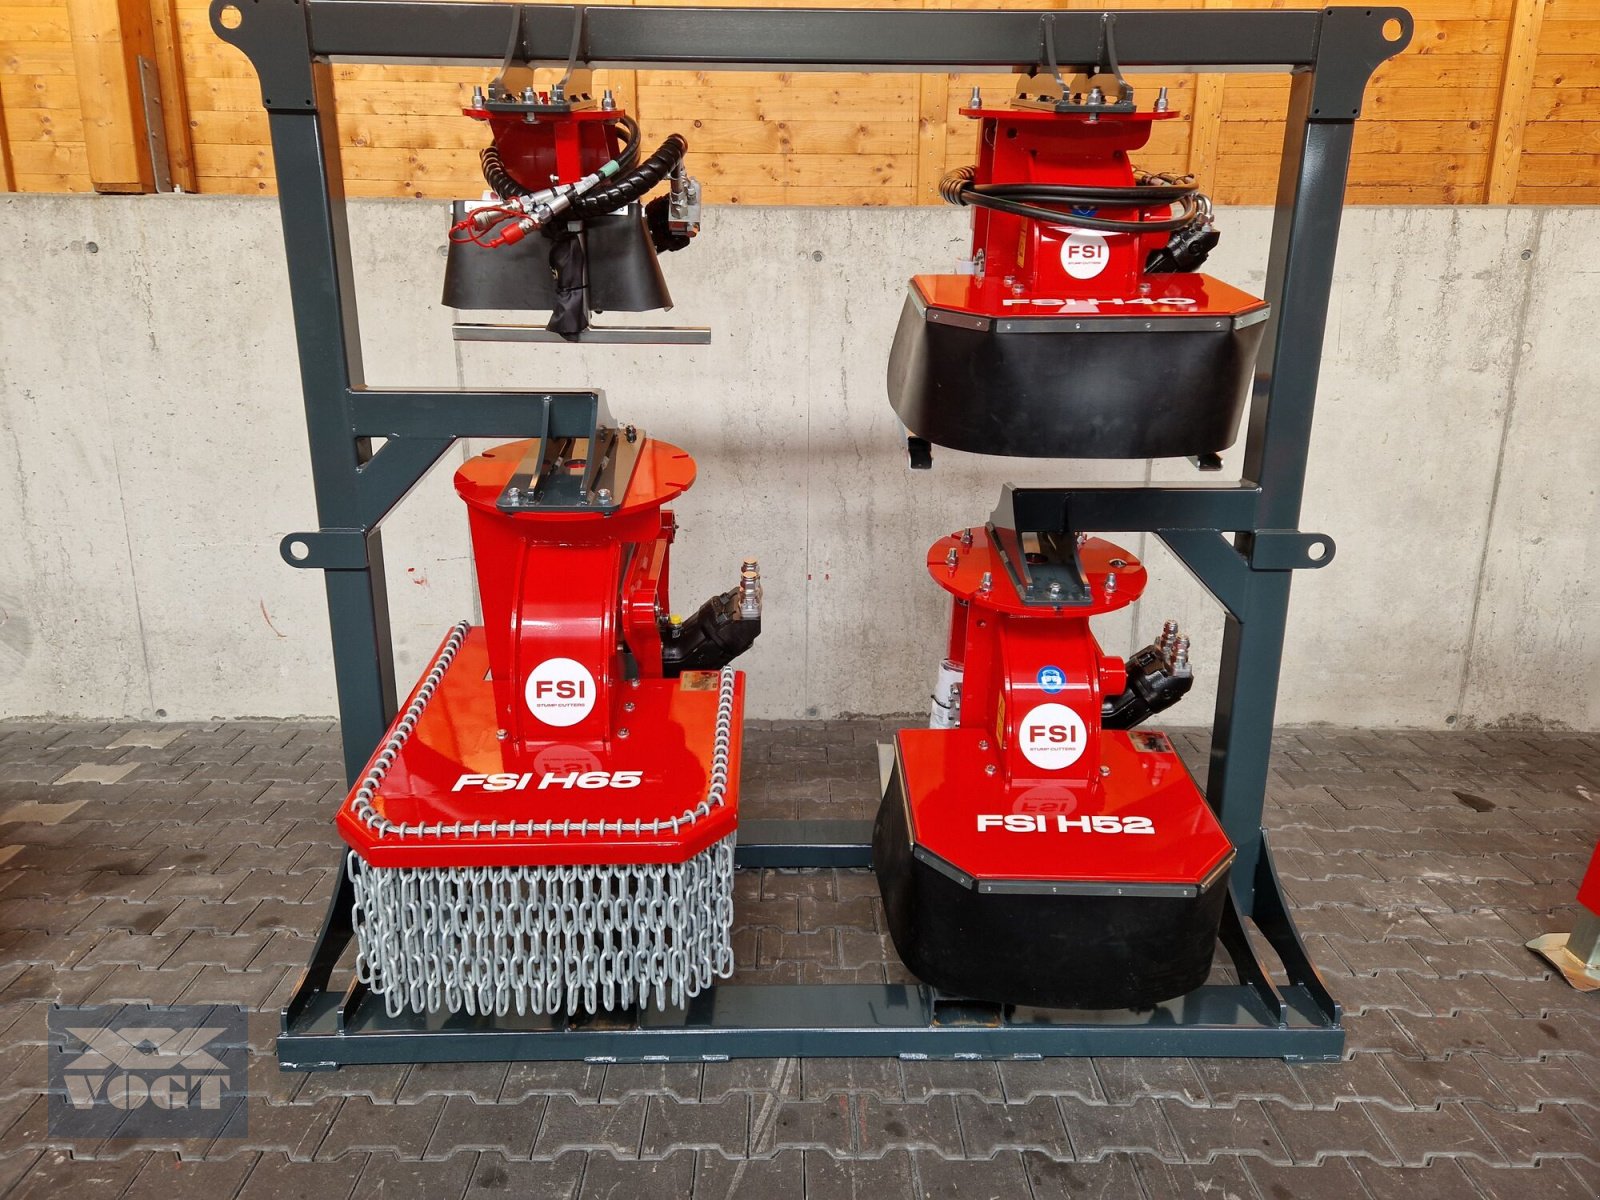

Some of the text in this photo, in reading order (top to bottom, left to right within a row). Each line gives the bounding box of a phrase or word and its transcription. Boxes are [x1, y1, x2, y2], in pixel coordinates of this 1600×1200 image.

[1068, 245, 1102, 258] FSI
[1087, 297, 1197, 305] H40
[536, 680, 585, 699] FSI
[1029, 725, 1076, 743] FSI
[451, 771, 644, 792] FSI H65
[977, 814, 1156, 834] FSI H52
